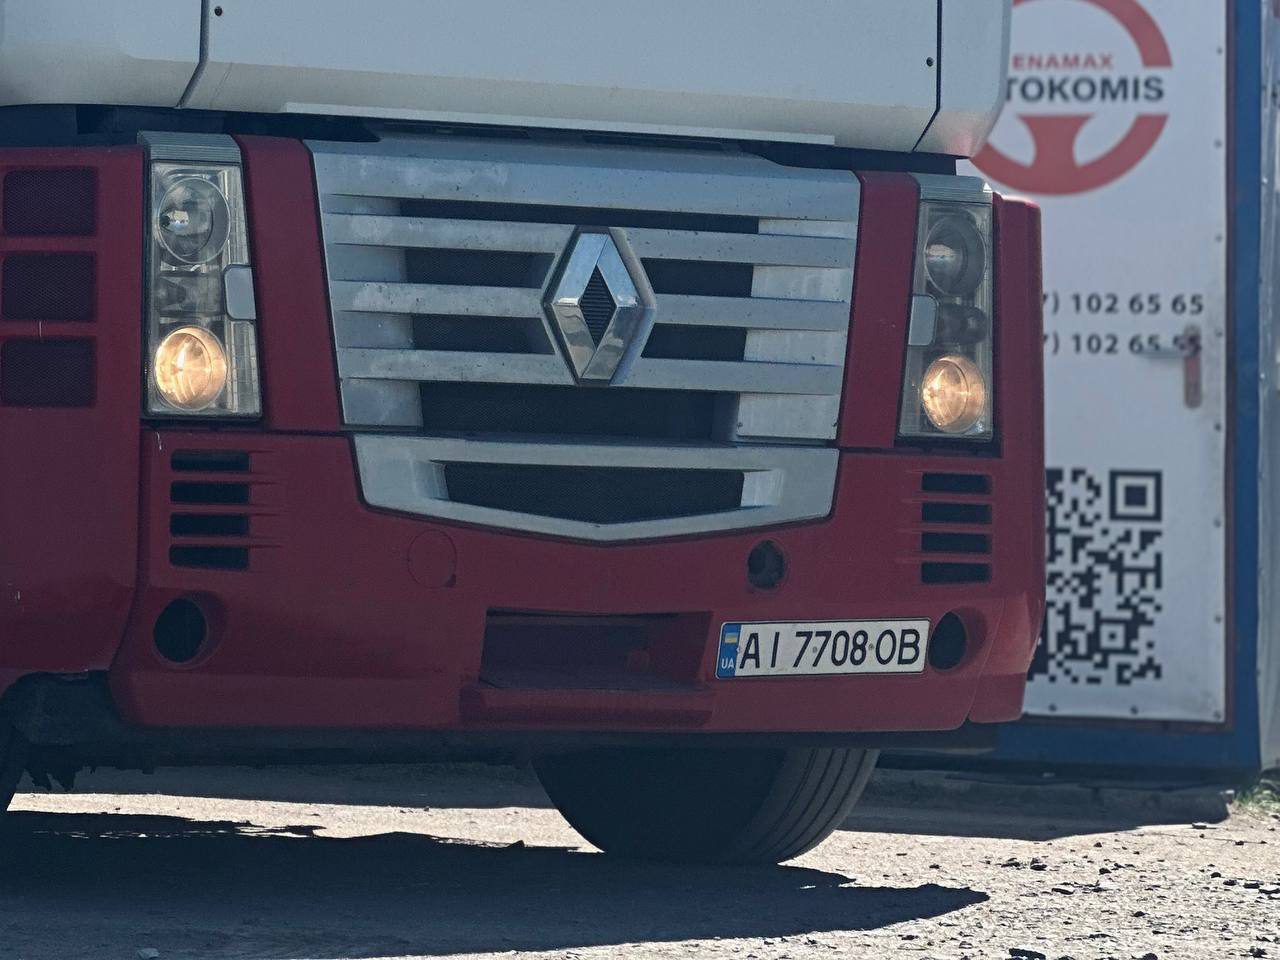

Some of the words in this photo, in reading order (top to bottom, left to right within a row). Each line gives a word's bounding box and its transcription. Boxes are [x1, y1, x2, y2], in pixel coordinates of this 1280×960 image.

[1072, 292, 1119, 314] 102
[1129, 292, 1161, 315] 65
[1171, 293, 1204, 316] 65
[1072, 333, 1119, 354] 102
[1129, 333, 1161, 356] 65
[739, 632, 780, 670] AI
[793, 630, 869, 668] 7708
[875, 629, 920, 666] OB
[721, 658, 736, 670] UA
